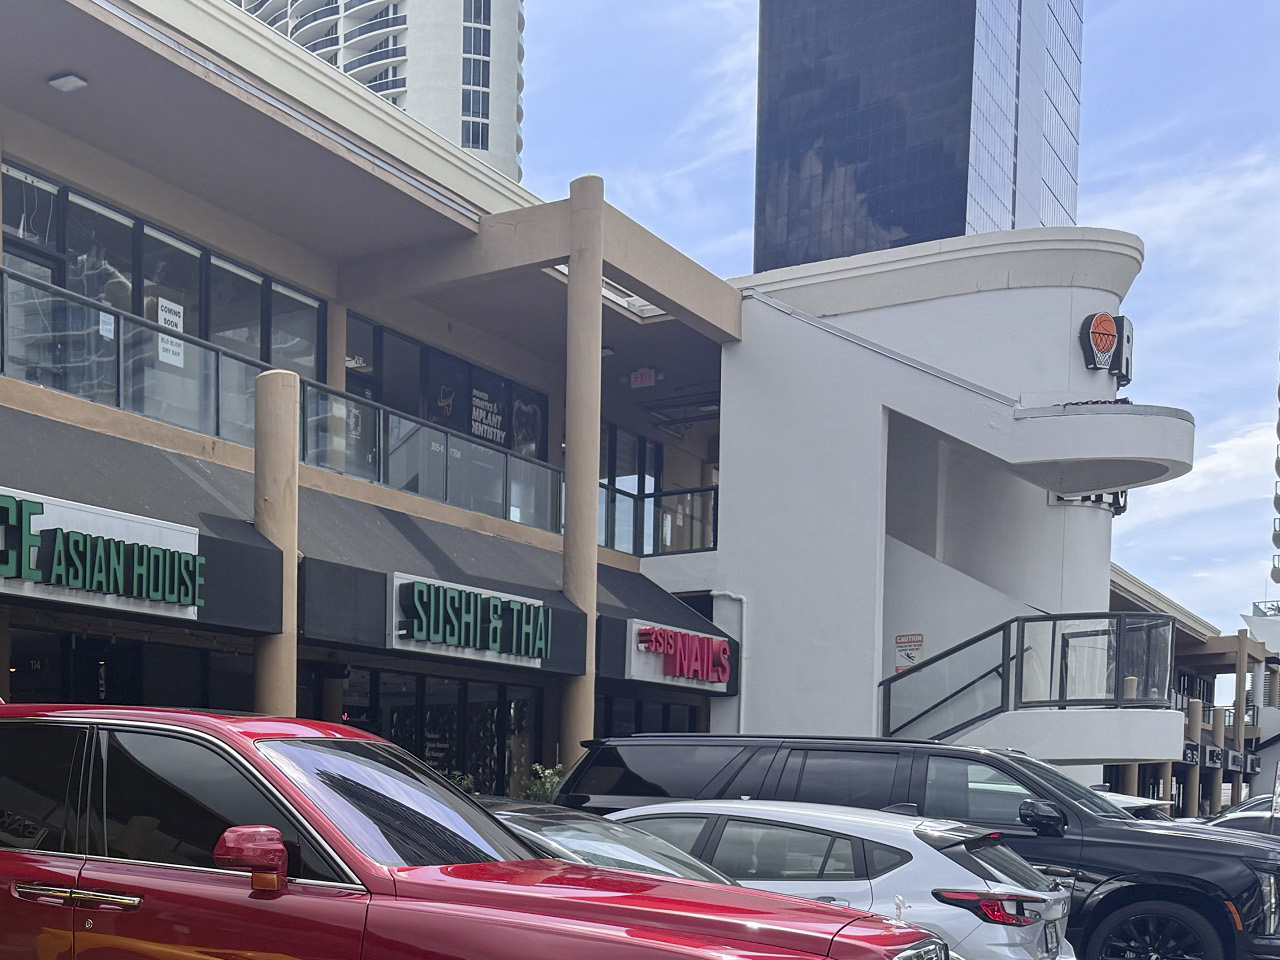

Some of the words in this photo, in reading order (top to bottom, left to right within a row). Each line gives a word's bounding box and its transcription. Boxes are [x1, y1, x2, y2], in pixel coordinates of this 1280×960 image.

[160, 304, 182, 319] COMING
[163, 317, 179, 330] SOON
[472, 406, 502, 429] MPLANT
[51, 527, 125, 596] ASIAN
[132, 542, 206, 607] HOUSE
[413, 581, 482, 650] SUSHI
[489, 596, 502, 652] &
[510, 600, 552, 660] THAI
[896, 635, 923, 643] CAUTION
[649, 627, 675, 655] 3SIS
[675, 632, 731, 684] NAILS
